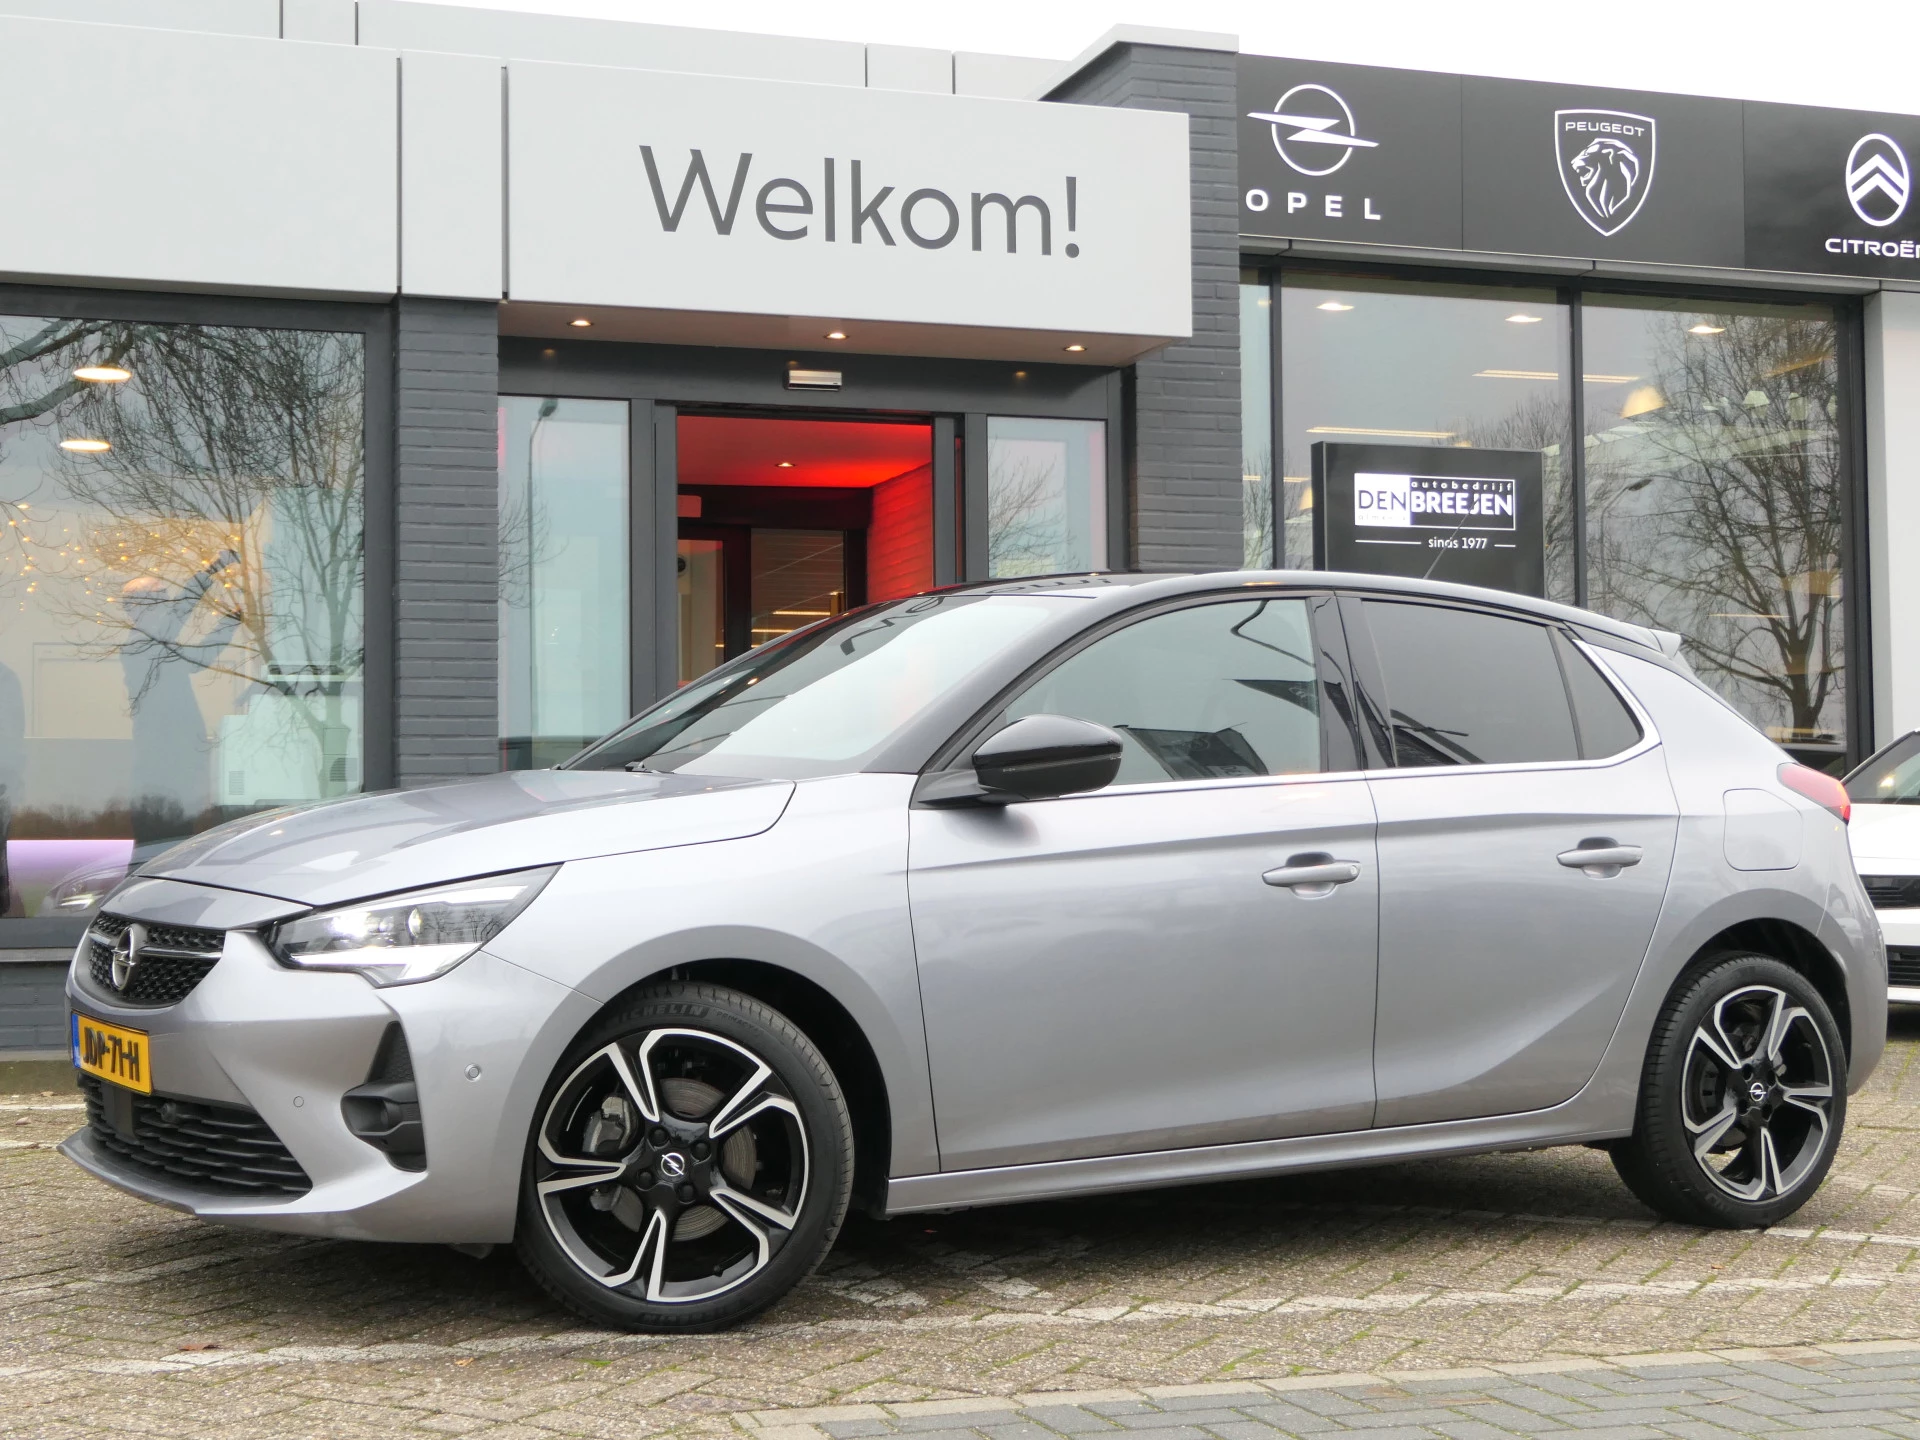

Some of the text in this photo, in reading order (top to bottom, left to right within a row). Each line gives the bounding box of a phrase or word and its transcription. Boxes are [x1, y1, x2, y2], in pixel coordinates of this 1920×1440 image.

[1564, 121, 1645, 137] PEUGEOT
[639, 145, 1080, 259] Welkom!
[1246, 188, 1382, 221] OPEL
[1411, 480, 1512, 493] autobedrijf
[1358, 489, 1513, 516] DEN BREEJEN
[1428, 537, 1488, 549] sinds 1977
[83, 1027, 140, 1082] JDP-71-H
